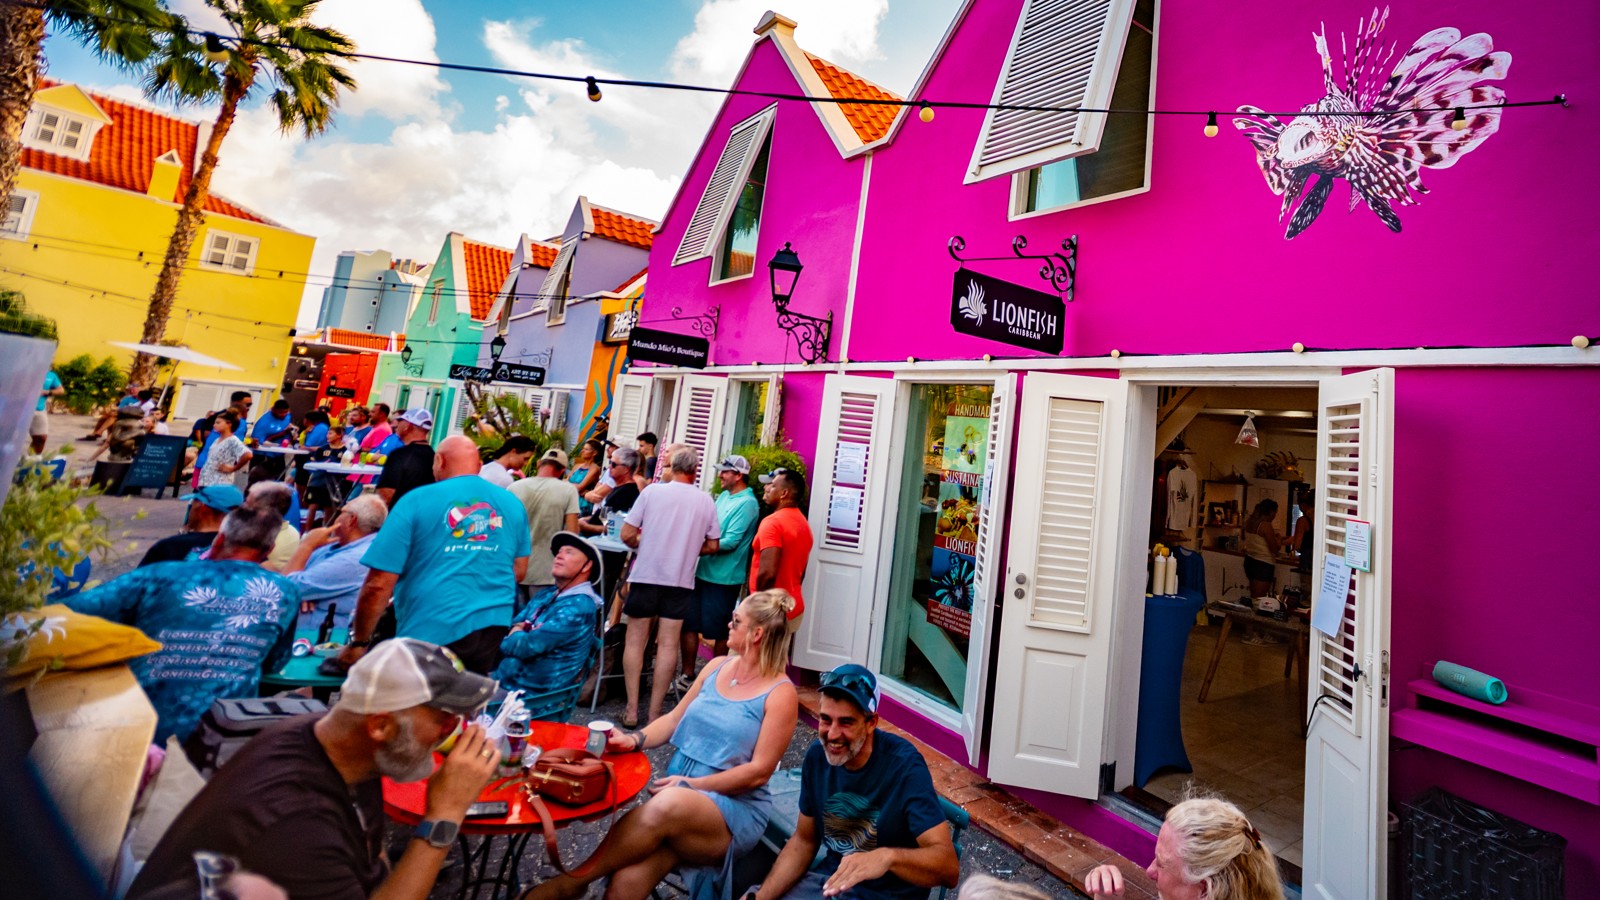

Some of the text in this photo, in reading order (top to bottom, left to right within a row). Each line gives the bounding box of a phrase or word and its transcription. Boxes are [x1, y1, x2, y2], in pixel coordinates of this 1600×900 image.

[992, 299, 1057, 336] LIONFISH
[1008, 325, 1041, 340] CARIBBEAN
[632, 340, 705, 358] Mundo Mio's Boutique
[945, 536, 977, 556] LIONFIS
